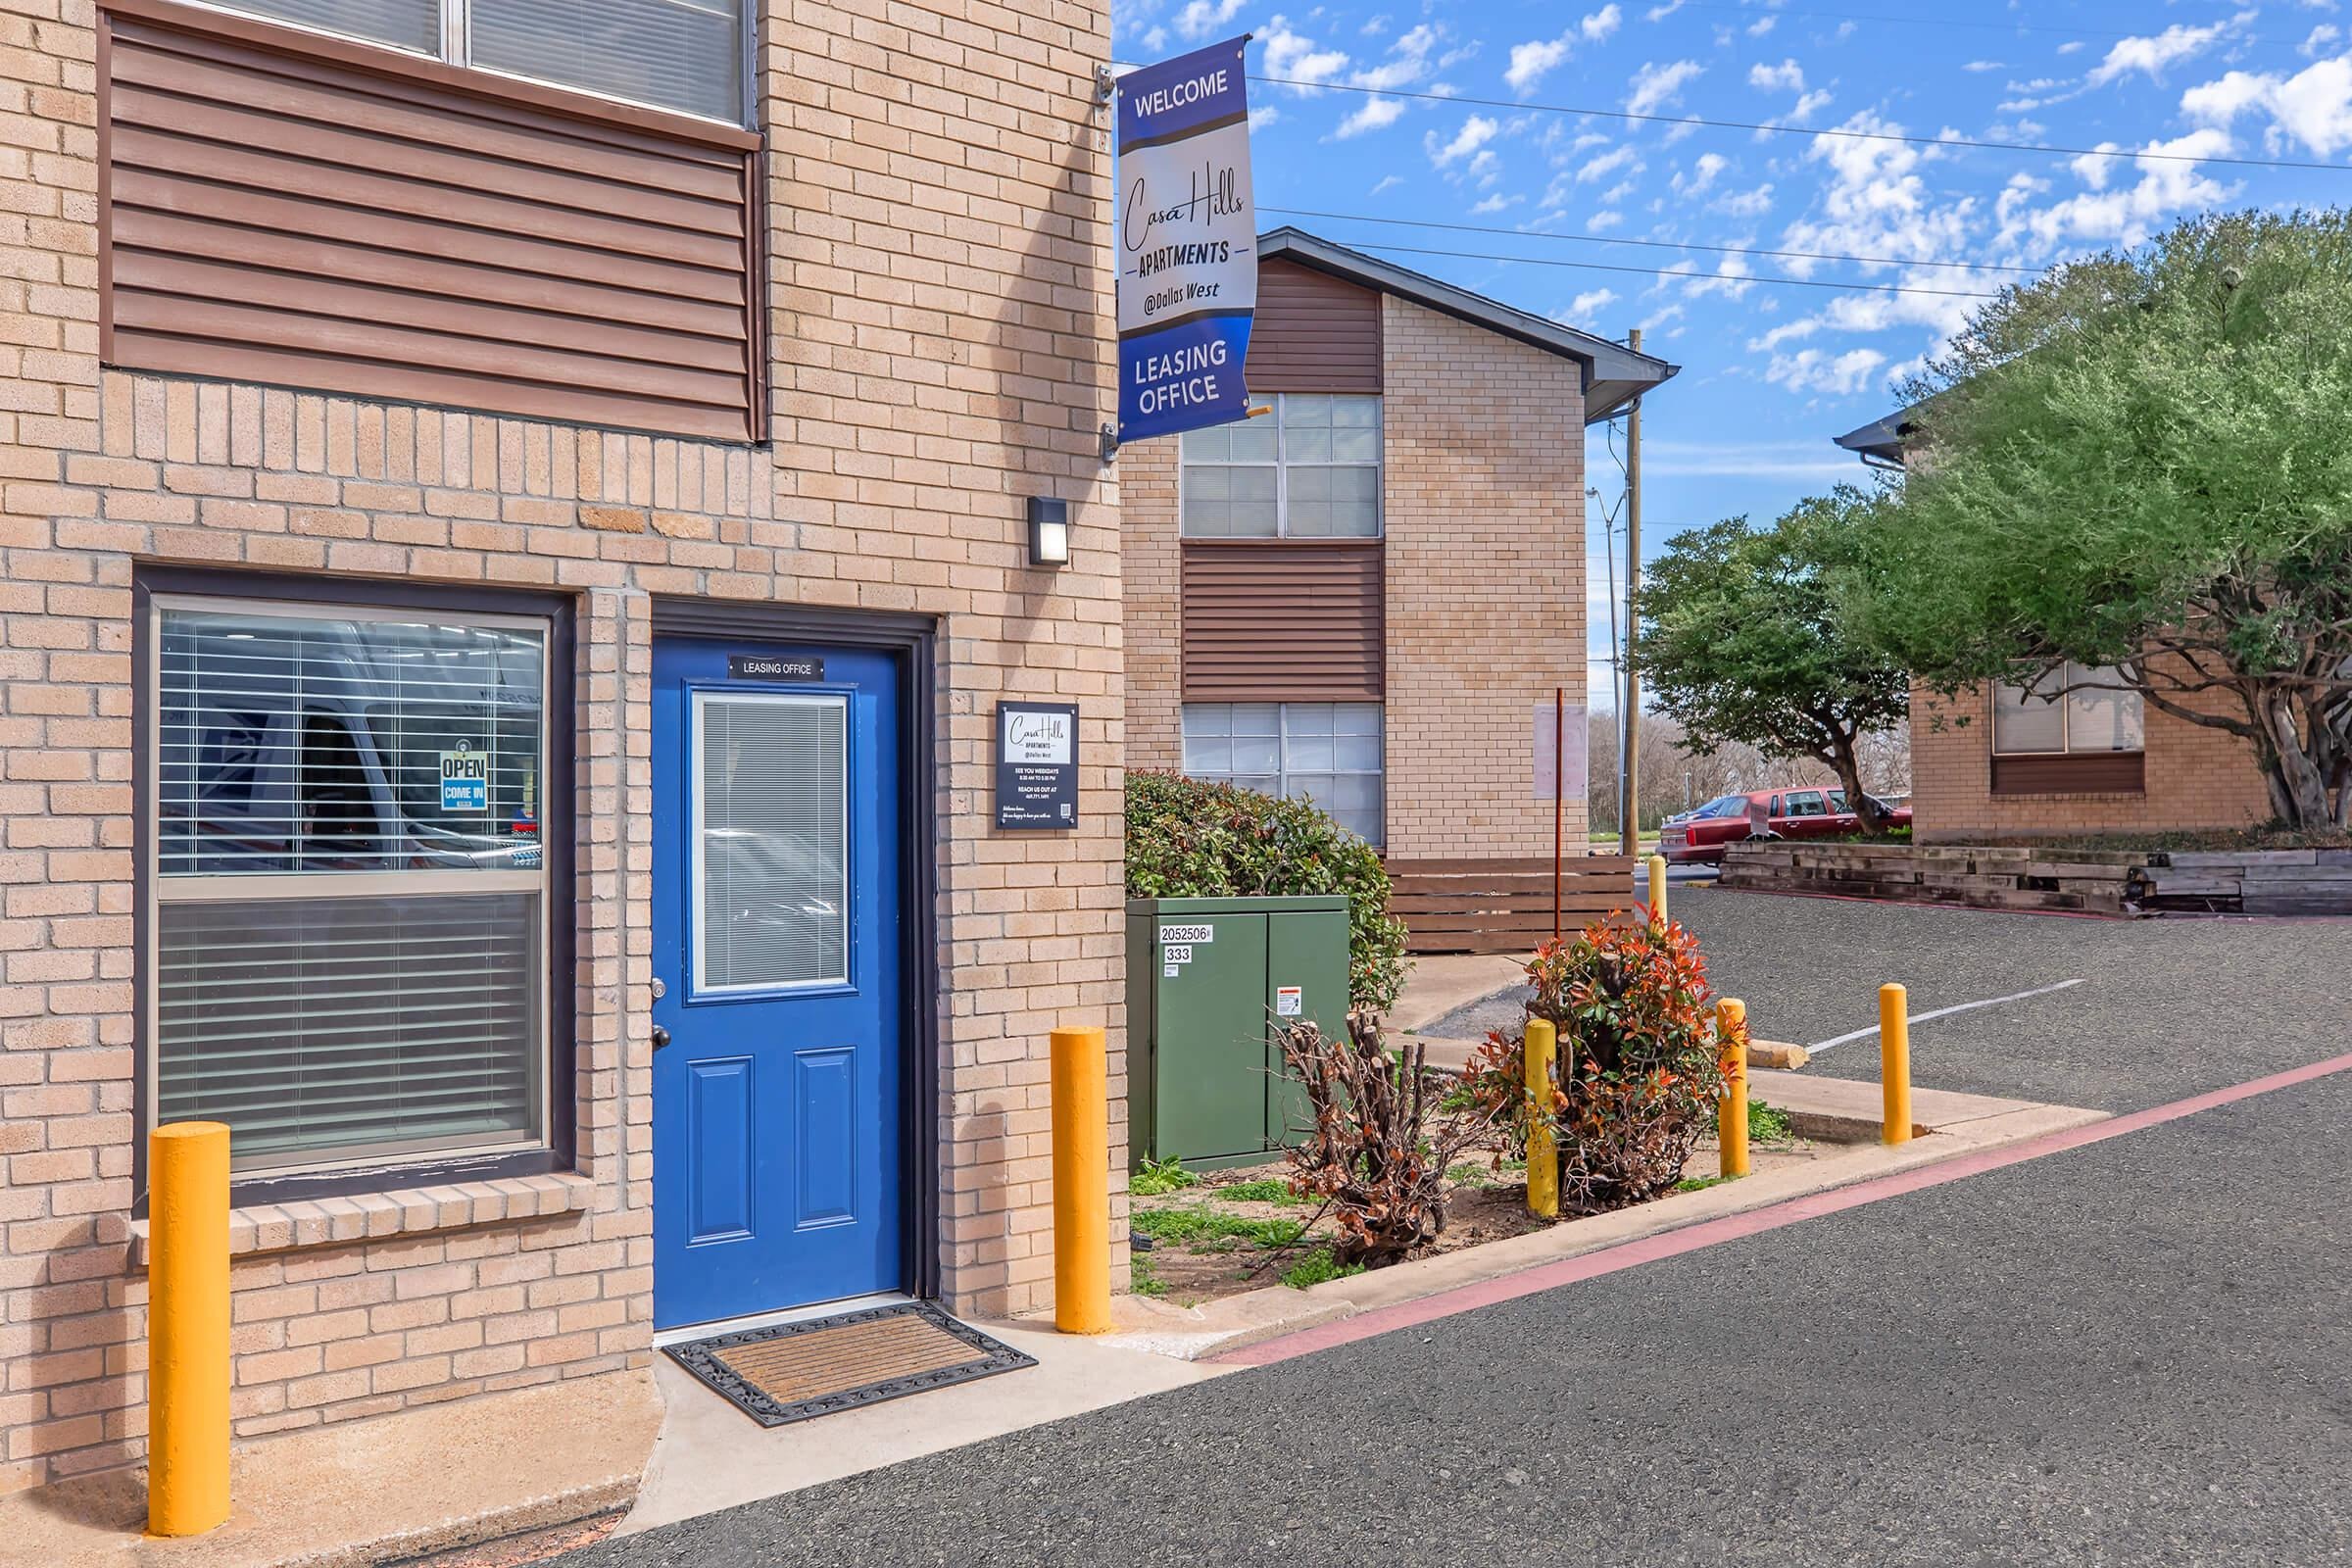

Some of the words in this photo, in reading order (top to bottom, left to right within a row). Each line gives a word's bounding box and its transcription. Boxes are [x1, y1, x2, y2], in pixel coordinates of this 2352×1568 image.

[1135, 69, 1229, 118] WELCOME
[1124, 177, 1184, 252] Casa
[1172, 161, 1245, 227] Hills
[1139, 240, 1230, 278] APARTMENTS
[1144, 288, 1183, 316] @Dallas
[1186, 282, 1221, 300] West
[1135, 339, 1227, 385] LEASING
[1139, 374, 1220, 414] OFFICE
[744, 662, 781, 674] LEASING
[782, 664, 811, 675] OFFICE
[1010, 714, 1040, 745] Casa
[1037, 715, 1064, 741] Hills
[442, 759, 485, 778] OPEN
[445, 787, 470, 799] COME
[473, 787, 484, 799] IN
[1166, 948, 1190, 960] 333
